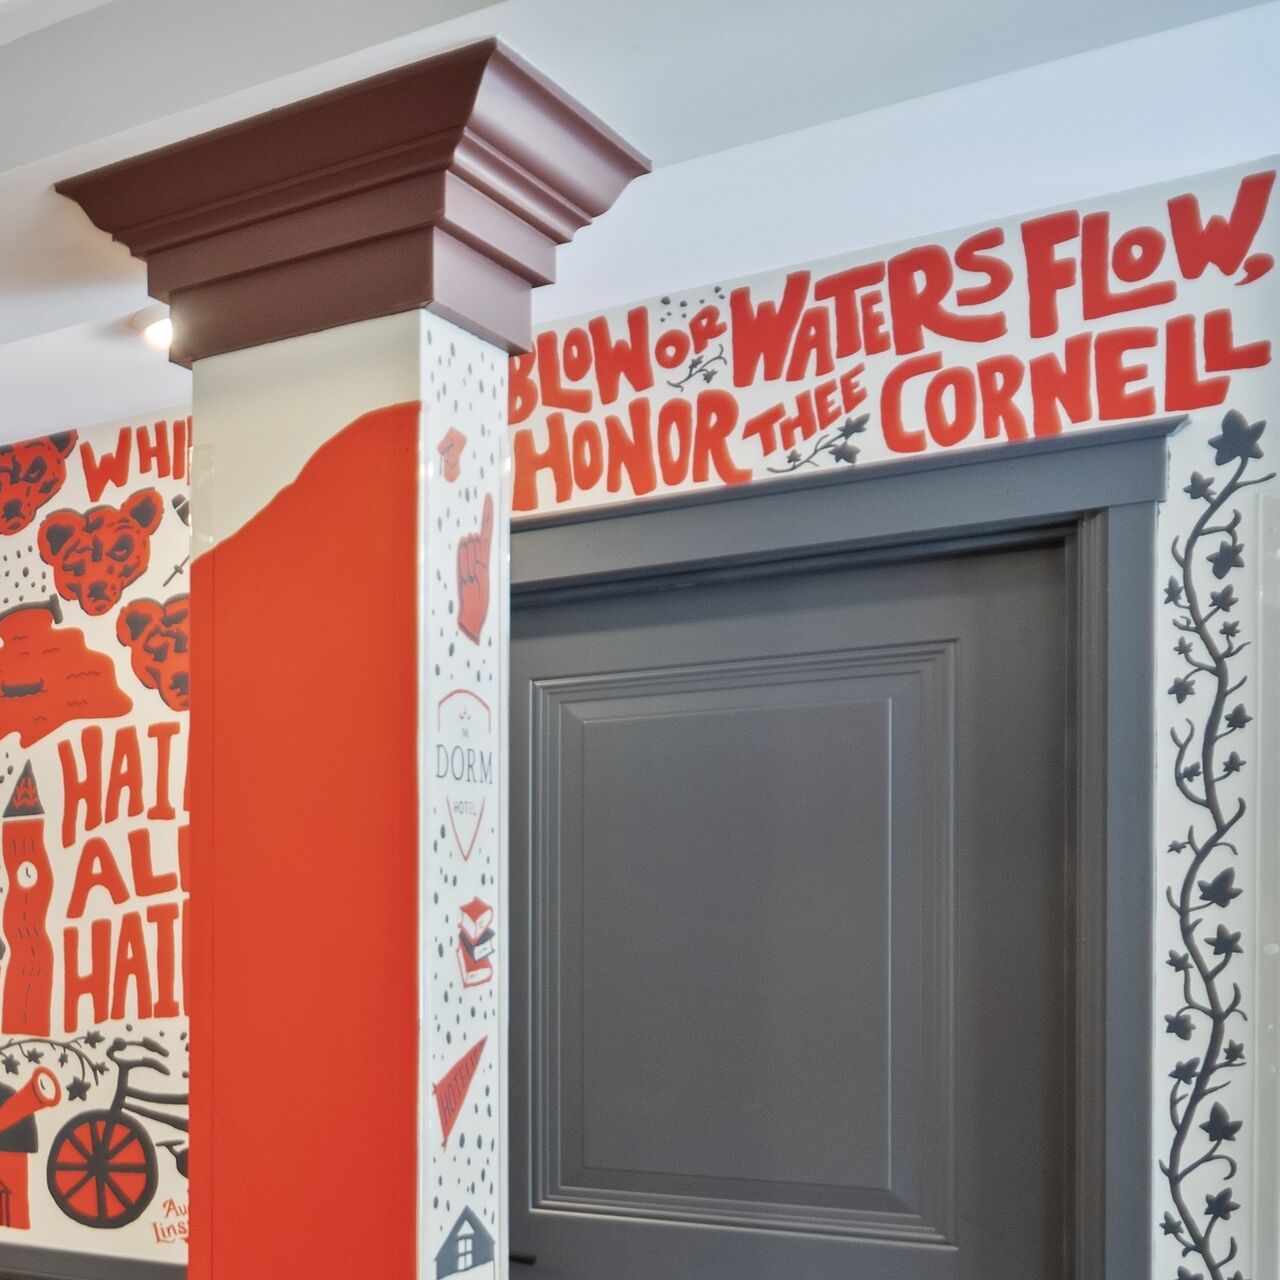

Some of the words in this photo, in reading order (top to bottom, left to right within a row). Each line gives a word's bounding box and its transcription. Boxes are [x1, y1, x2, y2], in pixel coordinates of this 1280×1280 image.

[508, 306, 655, 426] BLOW
[655, 305, 728, 369] OR
[730, 227, 1014, 388] WATERS
[1021, 169, 1278, 338] FLOW,
[512, 389, 753, 511] HONOR
[742, 362, 868, 457] THEE
[880, 309, 1273, 454] CORNELL
[79, 415, 192, 503] WHI
[57, 721, 190, 849] HAI
[436, 744, 493, 784] DORM
[453, 801, 477, 816] HOTEL
[63, 899, 190, 1034] HAI
[152, 1220, 189, 1243] Lins
[163, 1198, 188, 1218] Au
